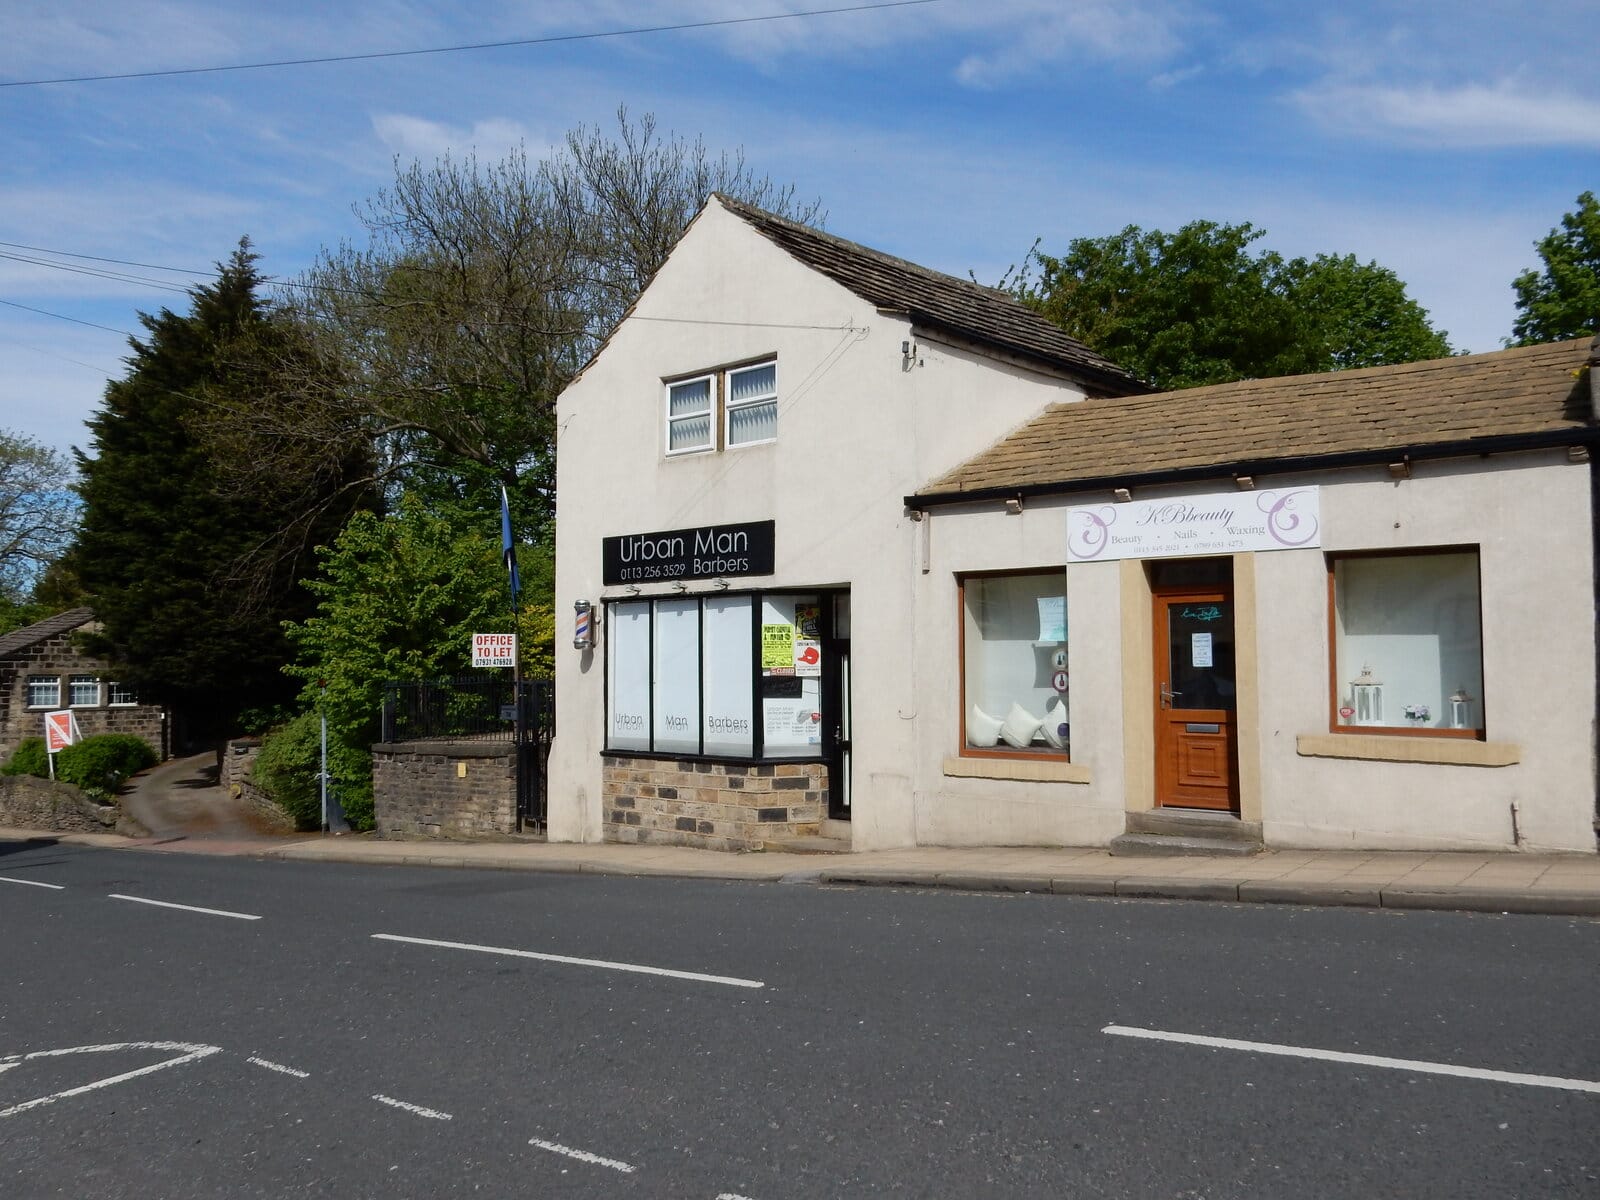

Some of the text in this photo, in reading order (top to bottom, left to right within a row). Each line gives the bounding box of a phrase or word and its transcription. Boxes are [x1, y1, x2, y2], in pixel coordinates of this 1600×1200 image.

[1111, 525, 1266, 545] Beauty Nails Waxing
[620, 528, 748, 563] Urban Man
[620, 563, 686, 580] 0113 256 3529
[693, 556, 749, 575] Barbers
[476, 635, 513, 645] OFFICE
[477, 647, 512, 657] TO LET
[615, 713, 643, 725] Urban
[665, 715, 688, 726] Man
[708, 715, 748, 729] Barbers
